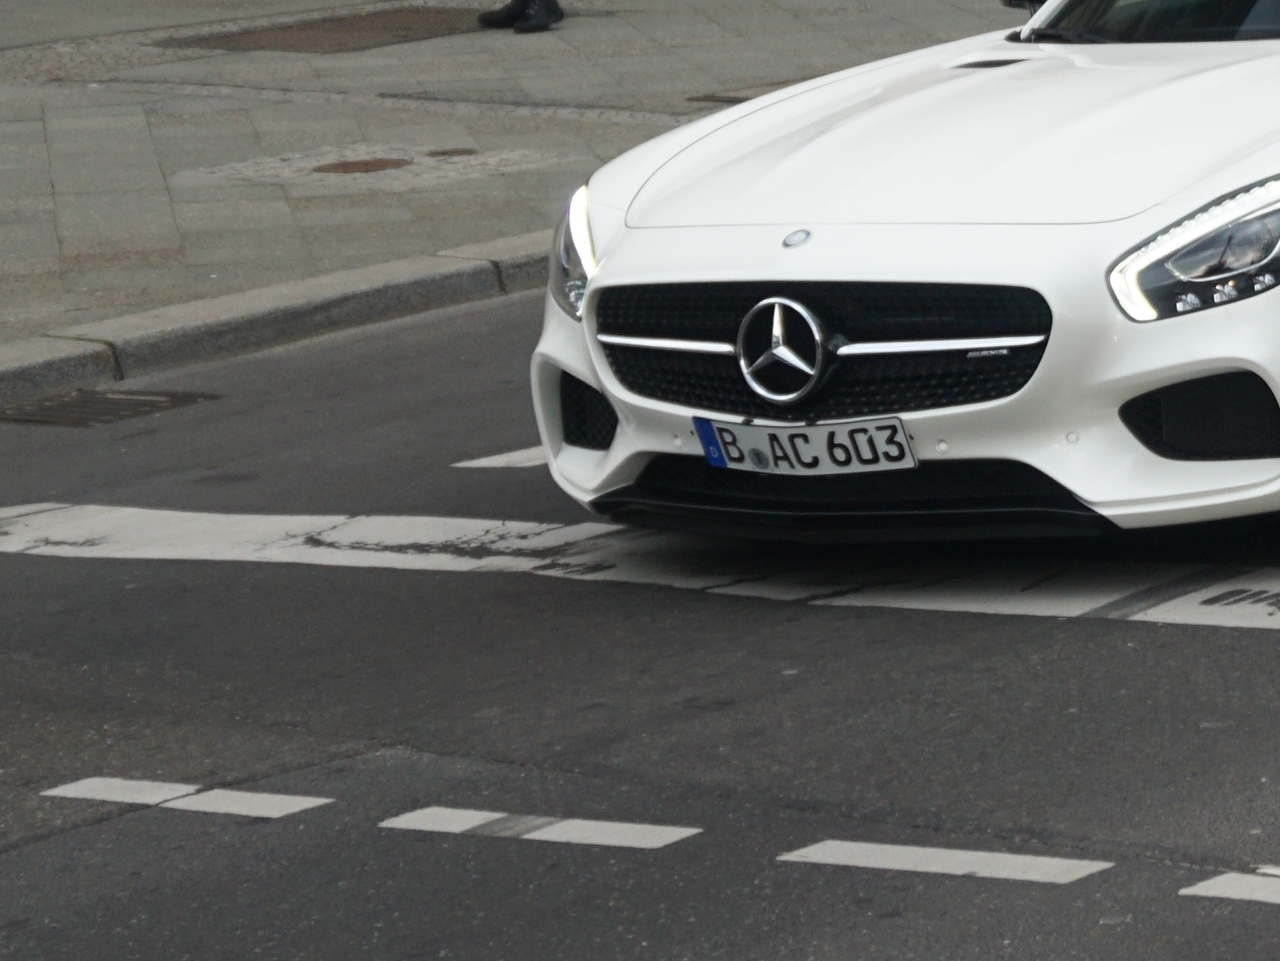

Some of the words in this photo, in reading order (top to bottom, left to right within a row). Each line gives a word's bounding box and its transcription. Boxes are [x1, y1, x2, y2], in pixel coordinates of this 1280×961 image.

[715, 426, 746, 464] B
[767, 432, 820, 470] AC
[826, 424, 906, 468] 603
